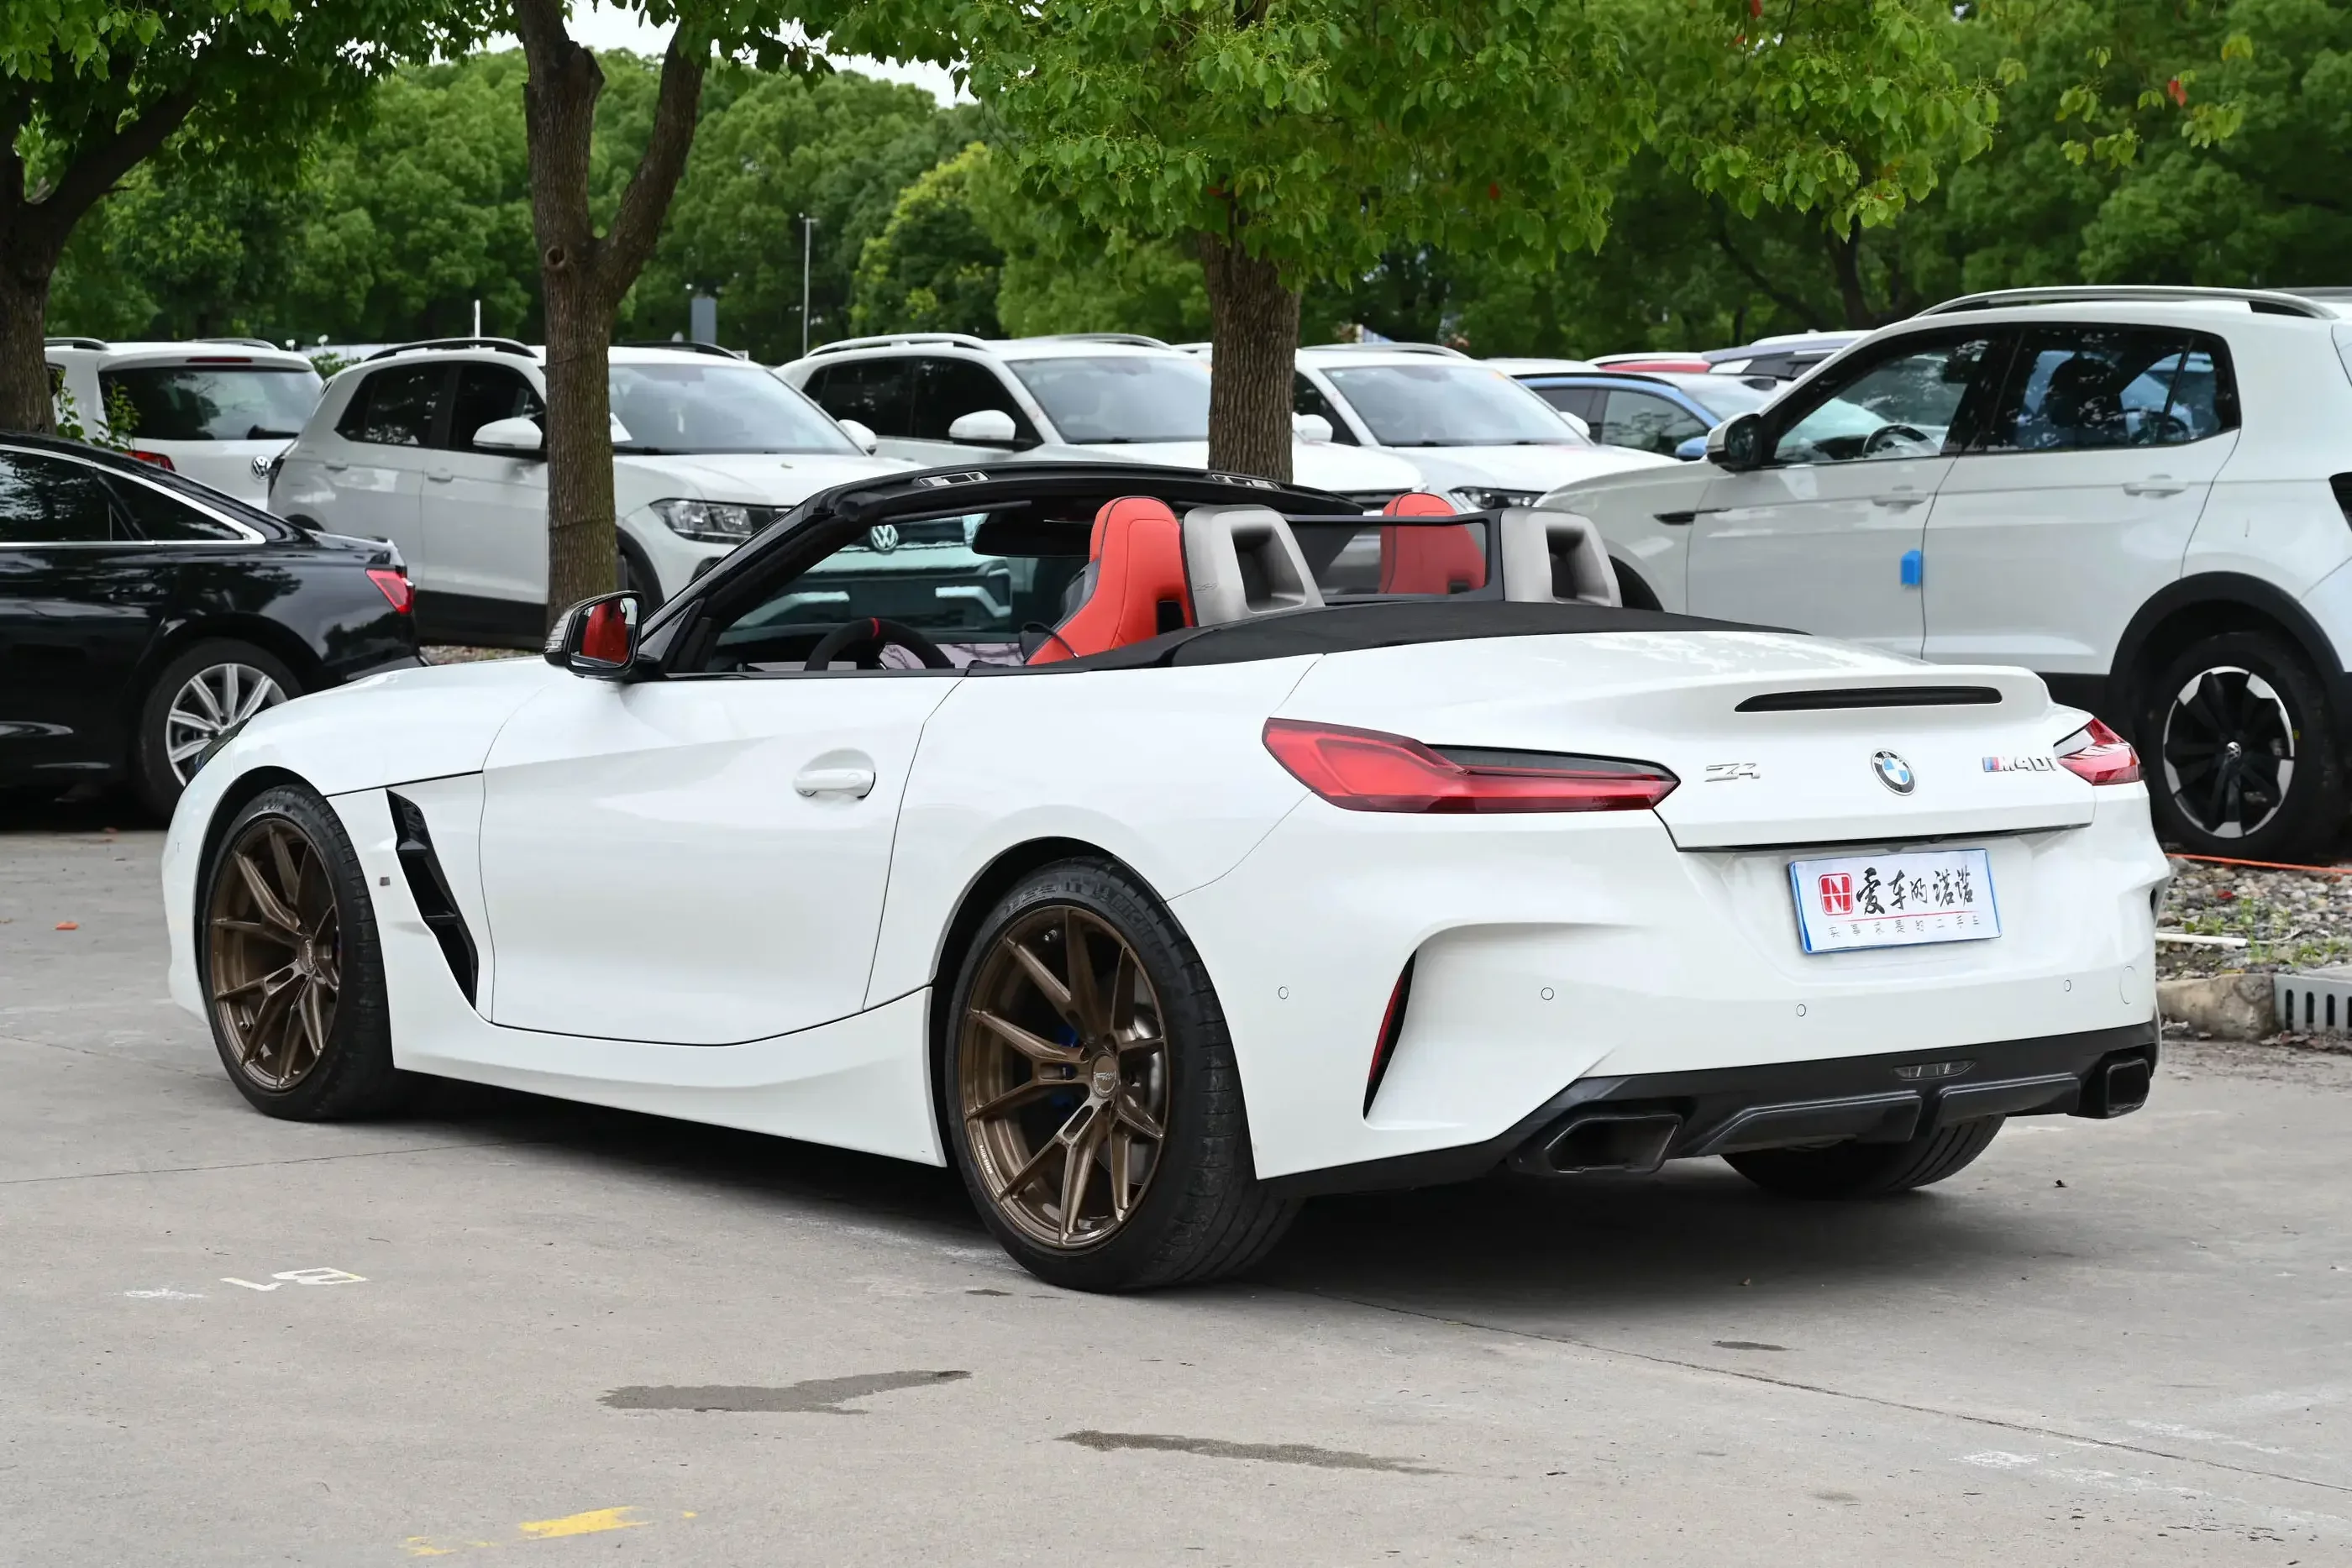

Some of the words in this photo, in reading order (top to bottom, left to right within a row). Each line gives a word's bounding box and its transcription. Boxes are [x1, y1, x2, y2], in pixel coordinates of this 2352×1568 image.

[1704, 762, 1761, 783] Z4
[1856, 865, 1973, 915] 爱车的诺诺
